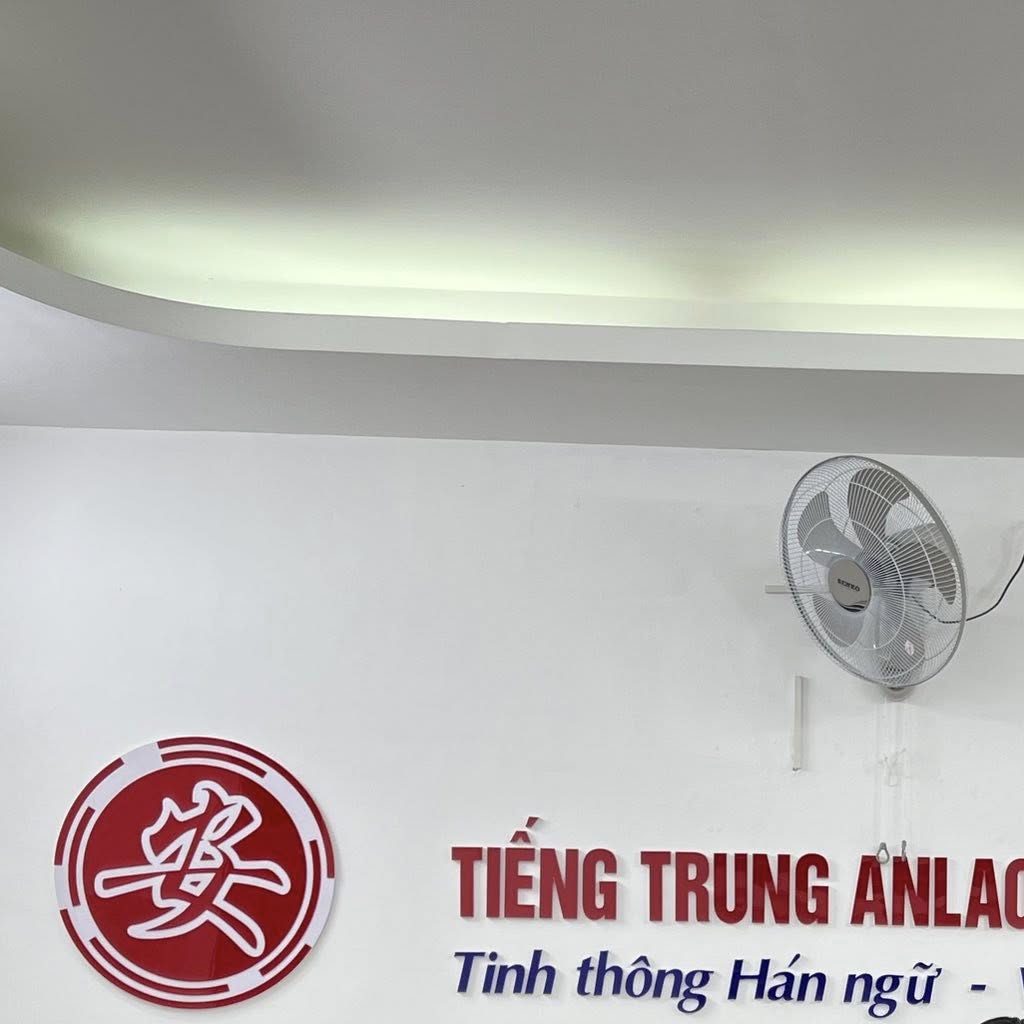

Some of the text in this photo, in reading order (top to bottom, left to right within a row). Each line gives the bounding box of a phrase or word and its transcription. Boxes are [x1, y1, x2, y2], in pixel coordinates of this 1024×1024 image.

[452, 817, 617, 922] TIẾNG
[640, 850, 829, 926] TRUNG
[454, 950, 555, 994] Tinh
[577, 951, 714, 1013] thông
[728, 954, 826, 1002] Hán
[843, 962, 942, 1018] ngữ
